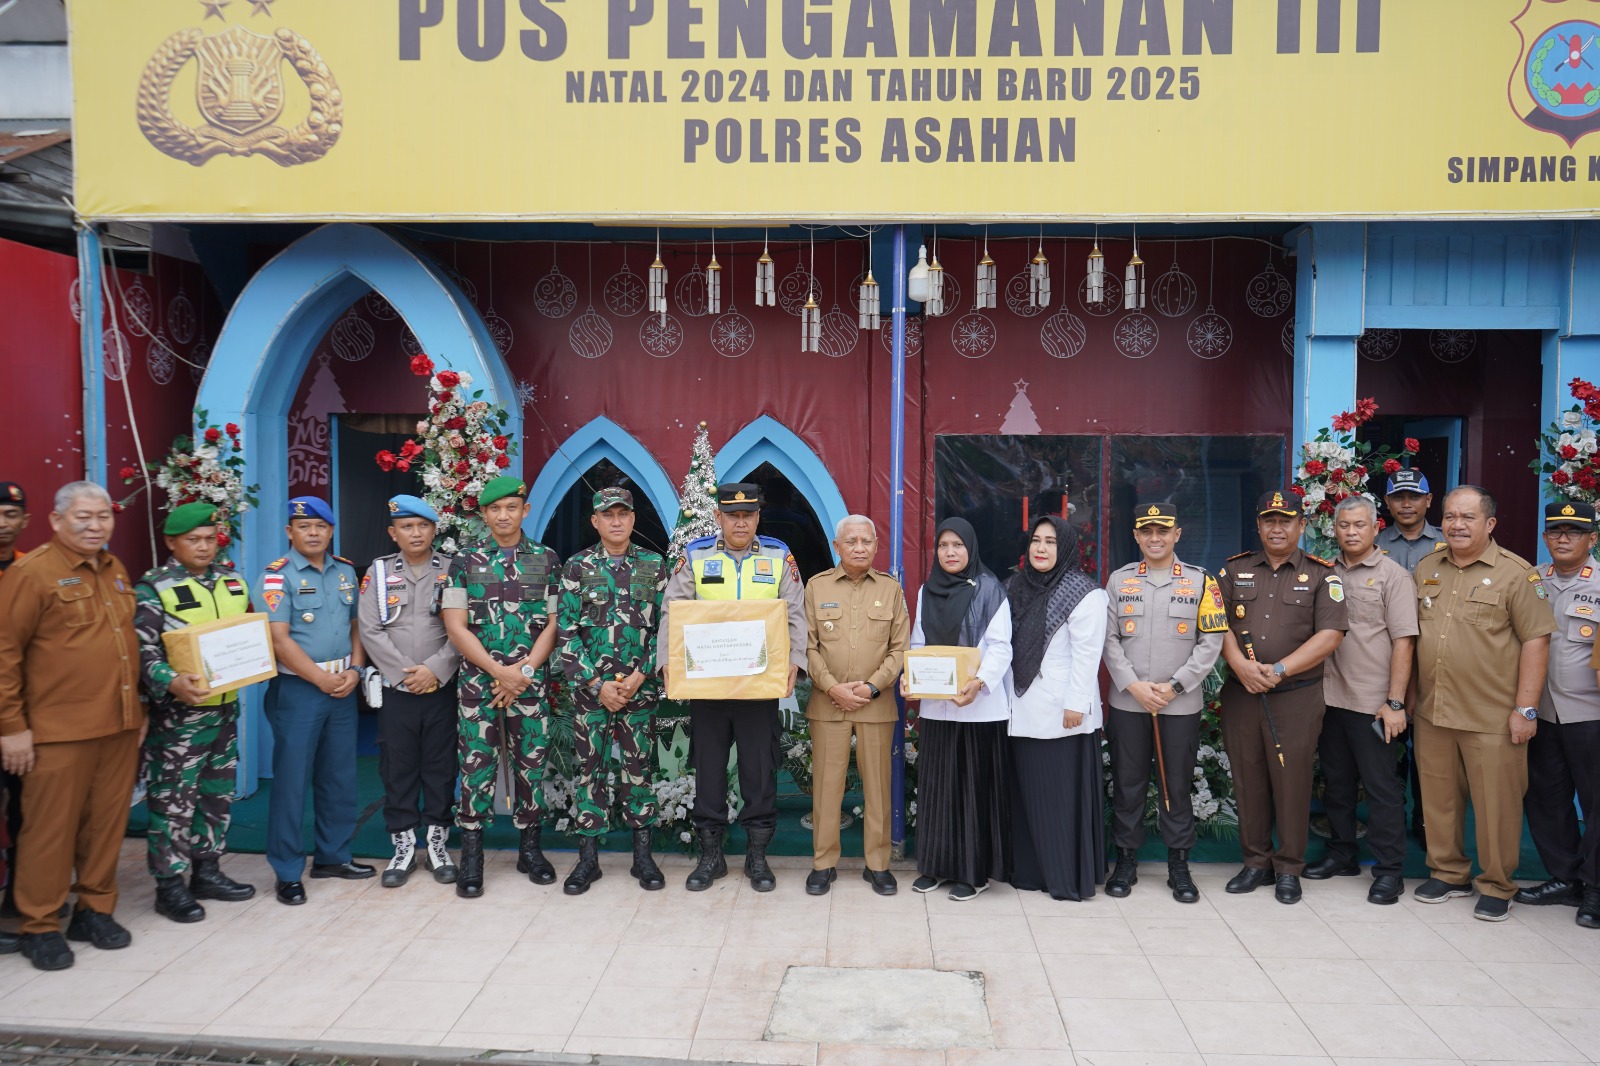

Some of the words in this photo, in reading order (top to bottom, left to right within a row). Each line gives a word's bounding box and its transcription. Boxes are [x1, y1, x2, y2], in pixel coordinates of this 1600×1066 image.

[399, 0, 567, 62] POS
[608, 0, 1233, 60] PENGAMANAN
[566, 71, 667, 103] NATAL
[681, 69, 769, 103] 2024
[784, 69, 852, 102] DAN
[867, 68, 981, 102] TAHUN
[998, 67, 1091, 101] BARU
[1107, 66, 1199, 100] 2025
[684, 118, 861, 164] POLRES
[881, 117, 1075, 163] ASAHAN
[1447, 155, 1577, 183] SIMPANG
[1170, 596, 1198, 605] POLRI
